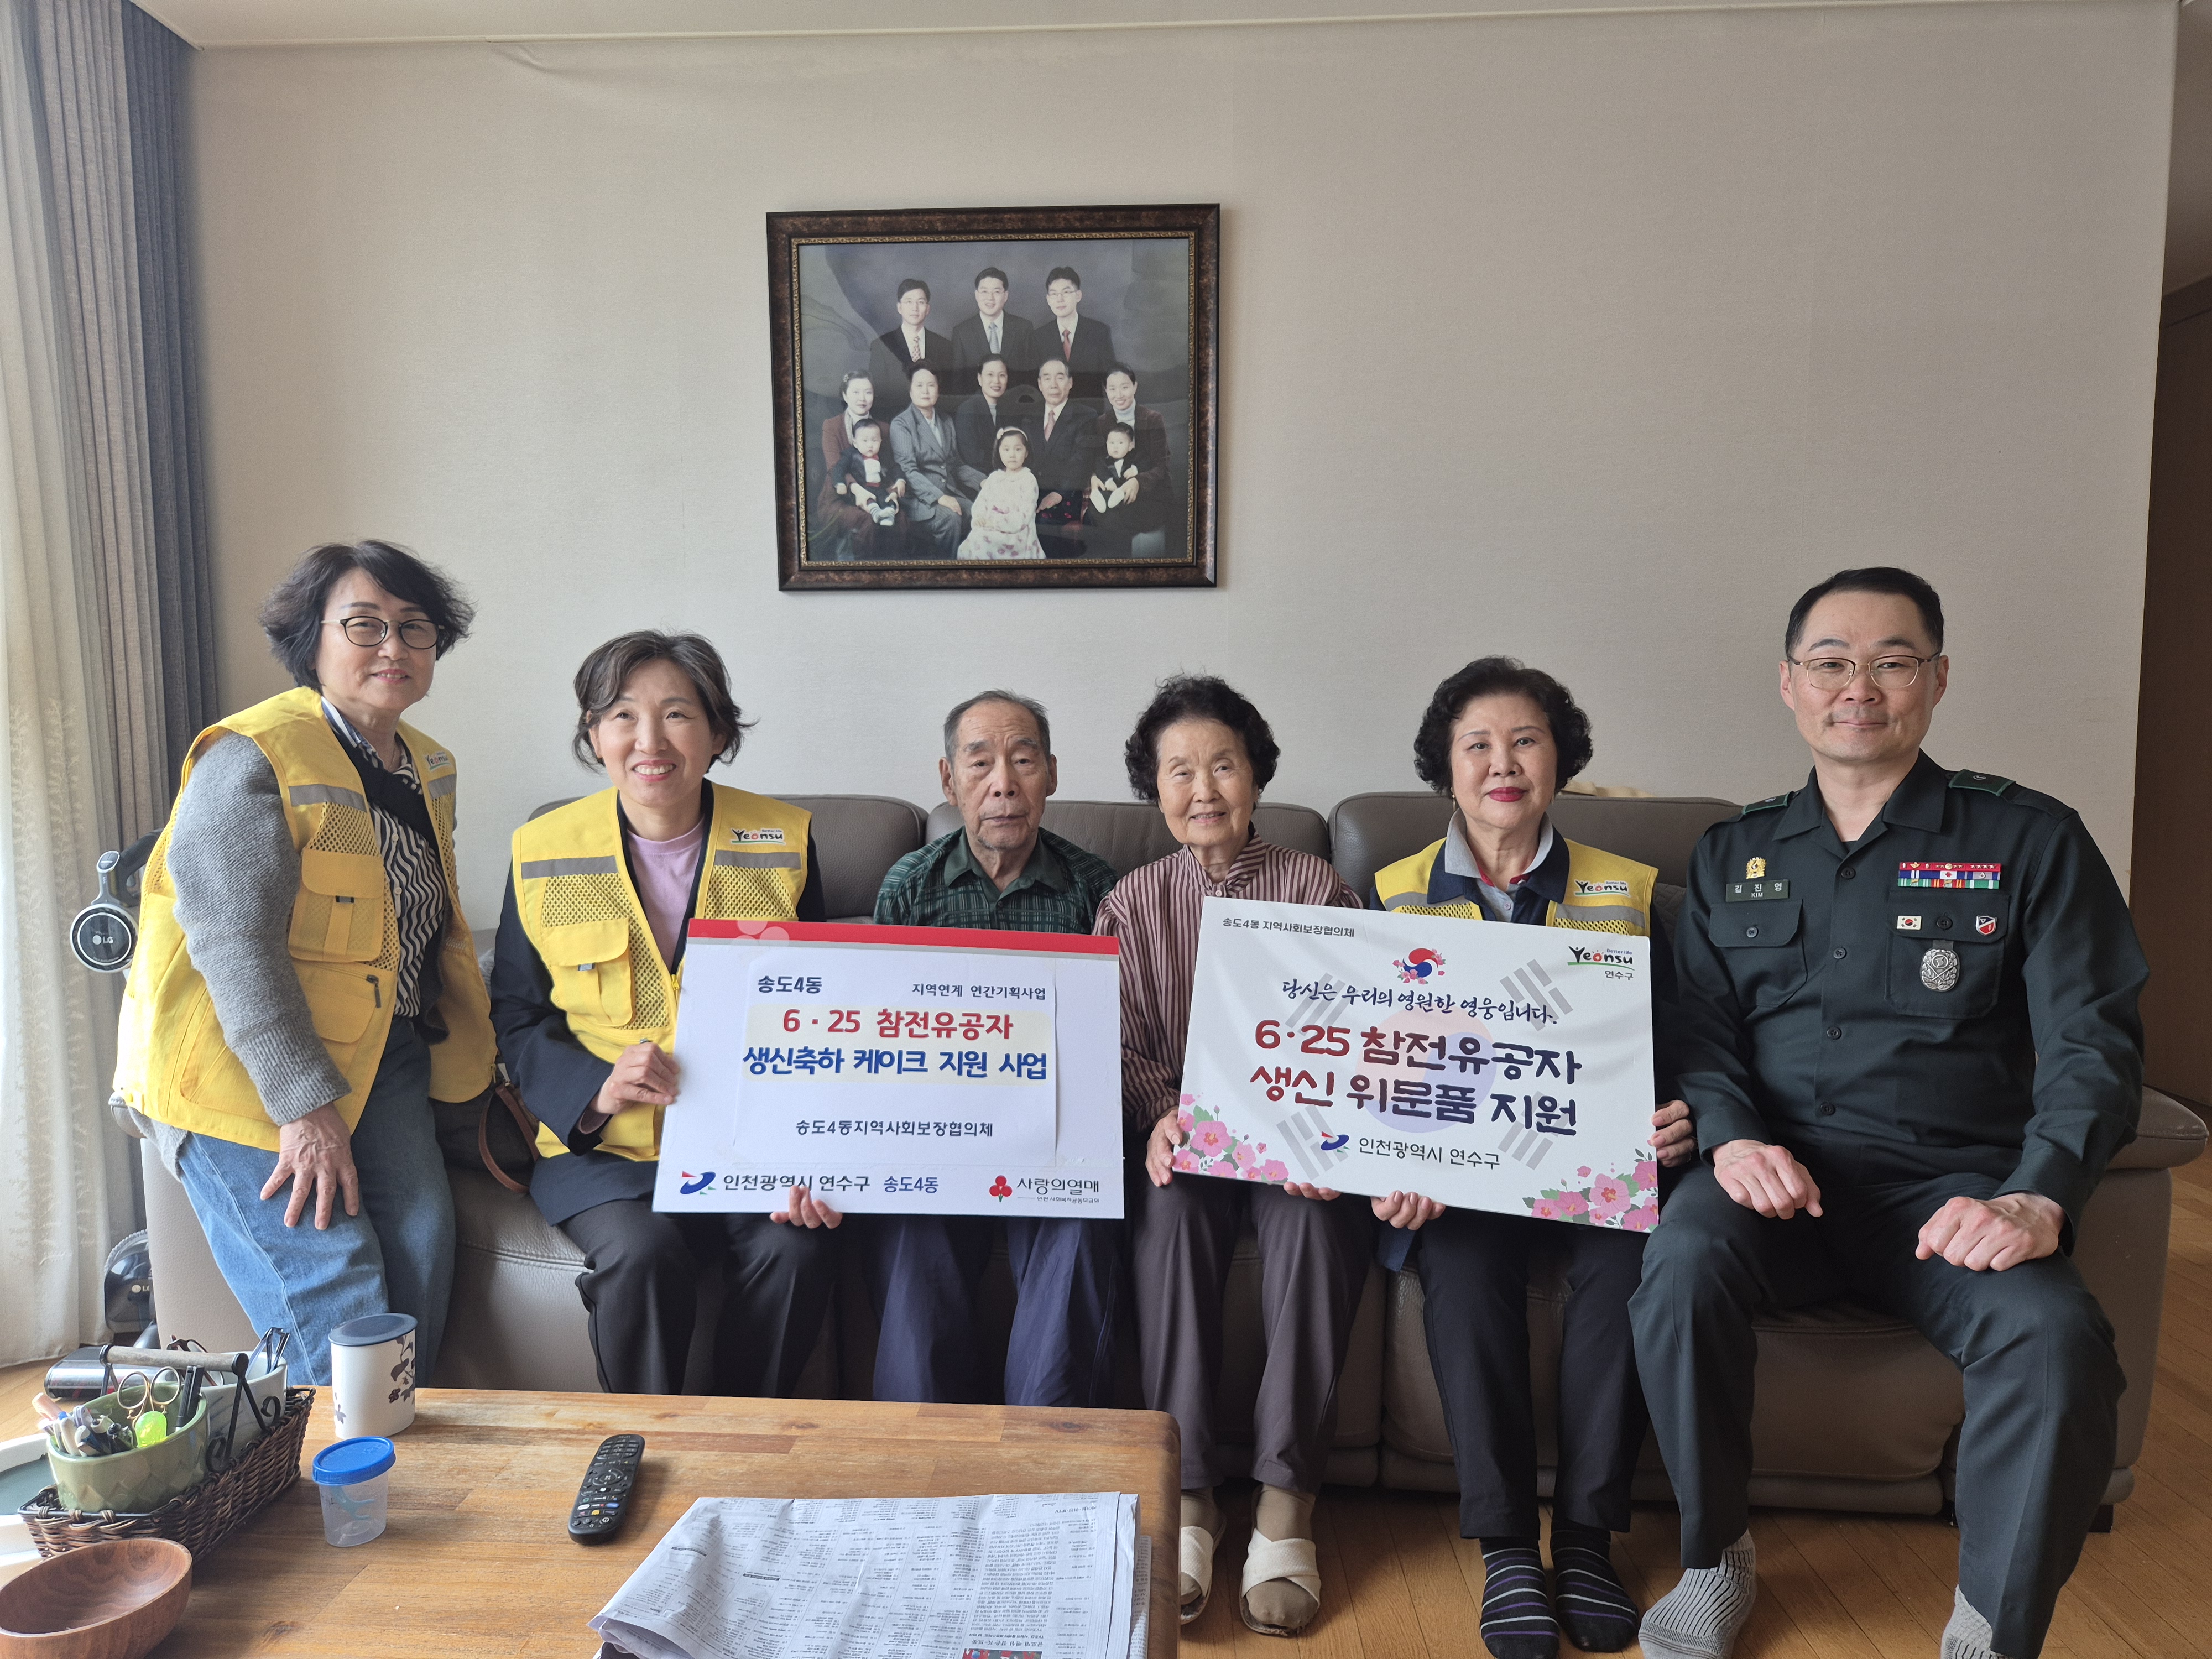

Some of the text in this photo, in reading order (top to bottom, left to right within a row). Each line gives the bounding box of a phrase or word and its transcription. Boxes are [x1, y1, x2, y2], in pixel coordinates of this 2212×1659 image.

[425, 755, 448, 767] Yeonsu
[732, 828, 783, 842] Yeonsu
[1575, 880, 1627, 893] Yeonsu
[1222, 917, 1355, 937] 송도4동 지역사회보장협의체
[1568, 946, 1633, 964] Yeonsu
[1605, 969, 1634, 981] 연수구
[758, 975, 823, 995] 송도4동
[912, 983, 1047, 1001] 지역연계 연간기획사업
[1282, 978, 1558, 1024] 당신은 우리의 영원한 영웅입니다.
[877, 1008, 1015, 1041] 참전유공자
[1255, 1019, 1583, 1086] 6·25 참전유공자
[742, 1045, 1047, 1081] 생신축하 케이크 지원 사업
[1250, 1065, 1578, 1137] 생신 위문품 지원
[796, 1119, 994, 1138] 송도4동지역사회보장협의체
[1359, 1137, 1500, 1170] 인천광역시 연수구
[723, 1175, 940, 1194] 인천광역시 연수구 송도4동
[1016, 1178, 1099, 1196] 사랑의열매
